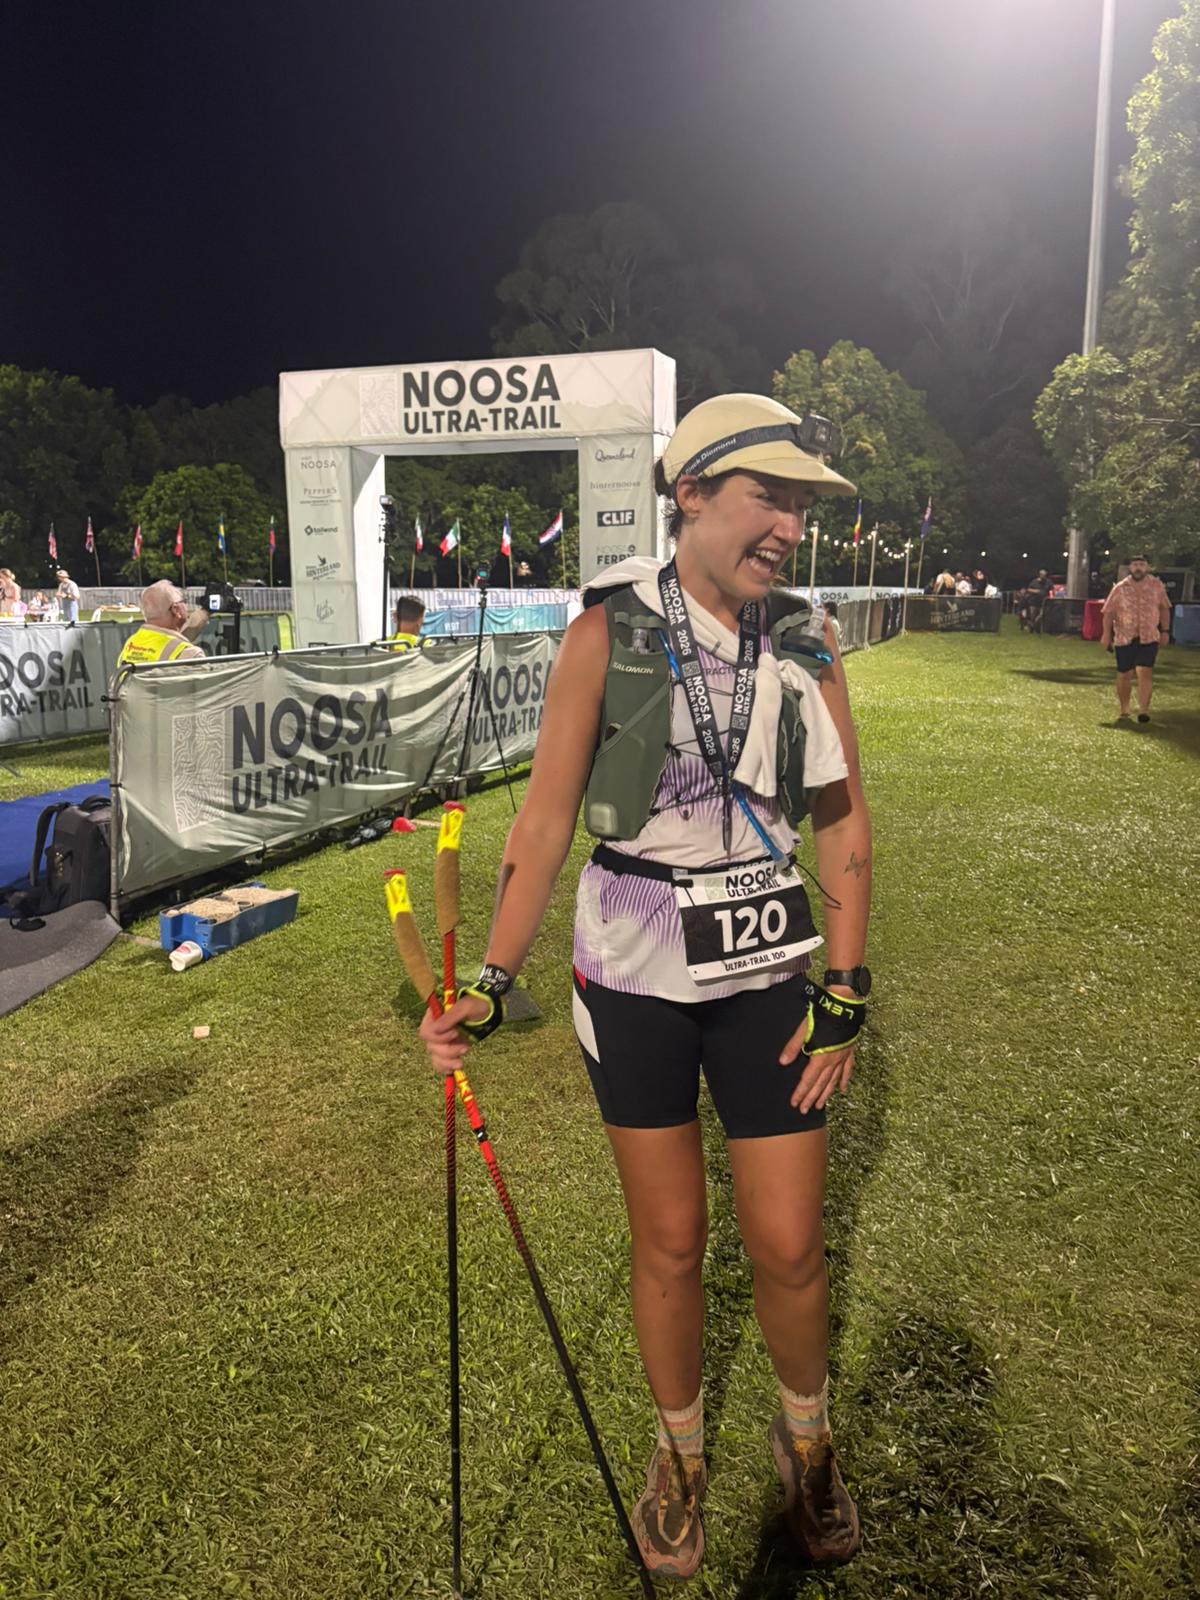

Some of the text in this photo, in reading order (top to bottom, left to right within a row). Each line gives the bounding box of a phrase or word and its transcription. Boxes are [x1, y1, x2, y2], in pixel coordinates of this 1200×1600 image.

[403, 363, 561, 408] NOOSA
[404, 405, 561, 435] ULTRA-TRAIL
[300, 460, 337, 469] NOOSA
[602, 511, 632, 525] CLIF
[660, 582, 676, 626] ULTRA-TRAIL
[668, 578, 692, 656] NOOSA 2026
[612, 661, 654, 675] SALOMON
[743, 640, 754, 663] 2026
[685, 678, 702, 725] ULTRA-TRAIL
[733, 667, 748, 714] NOOSA
[232, 687, 393, 769] NOOSA
[692, 675, 715, 756] NOOSA 2026
[729, 736, 742, 763] 2026
[232, 743, 388, 814] ULTRA-TRAIL
[714, 900, 788, 953] 120
[724, 950, 786, 972] ULTRA-TRAIL 100
[818, 995, 855, 1019] LEKI
